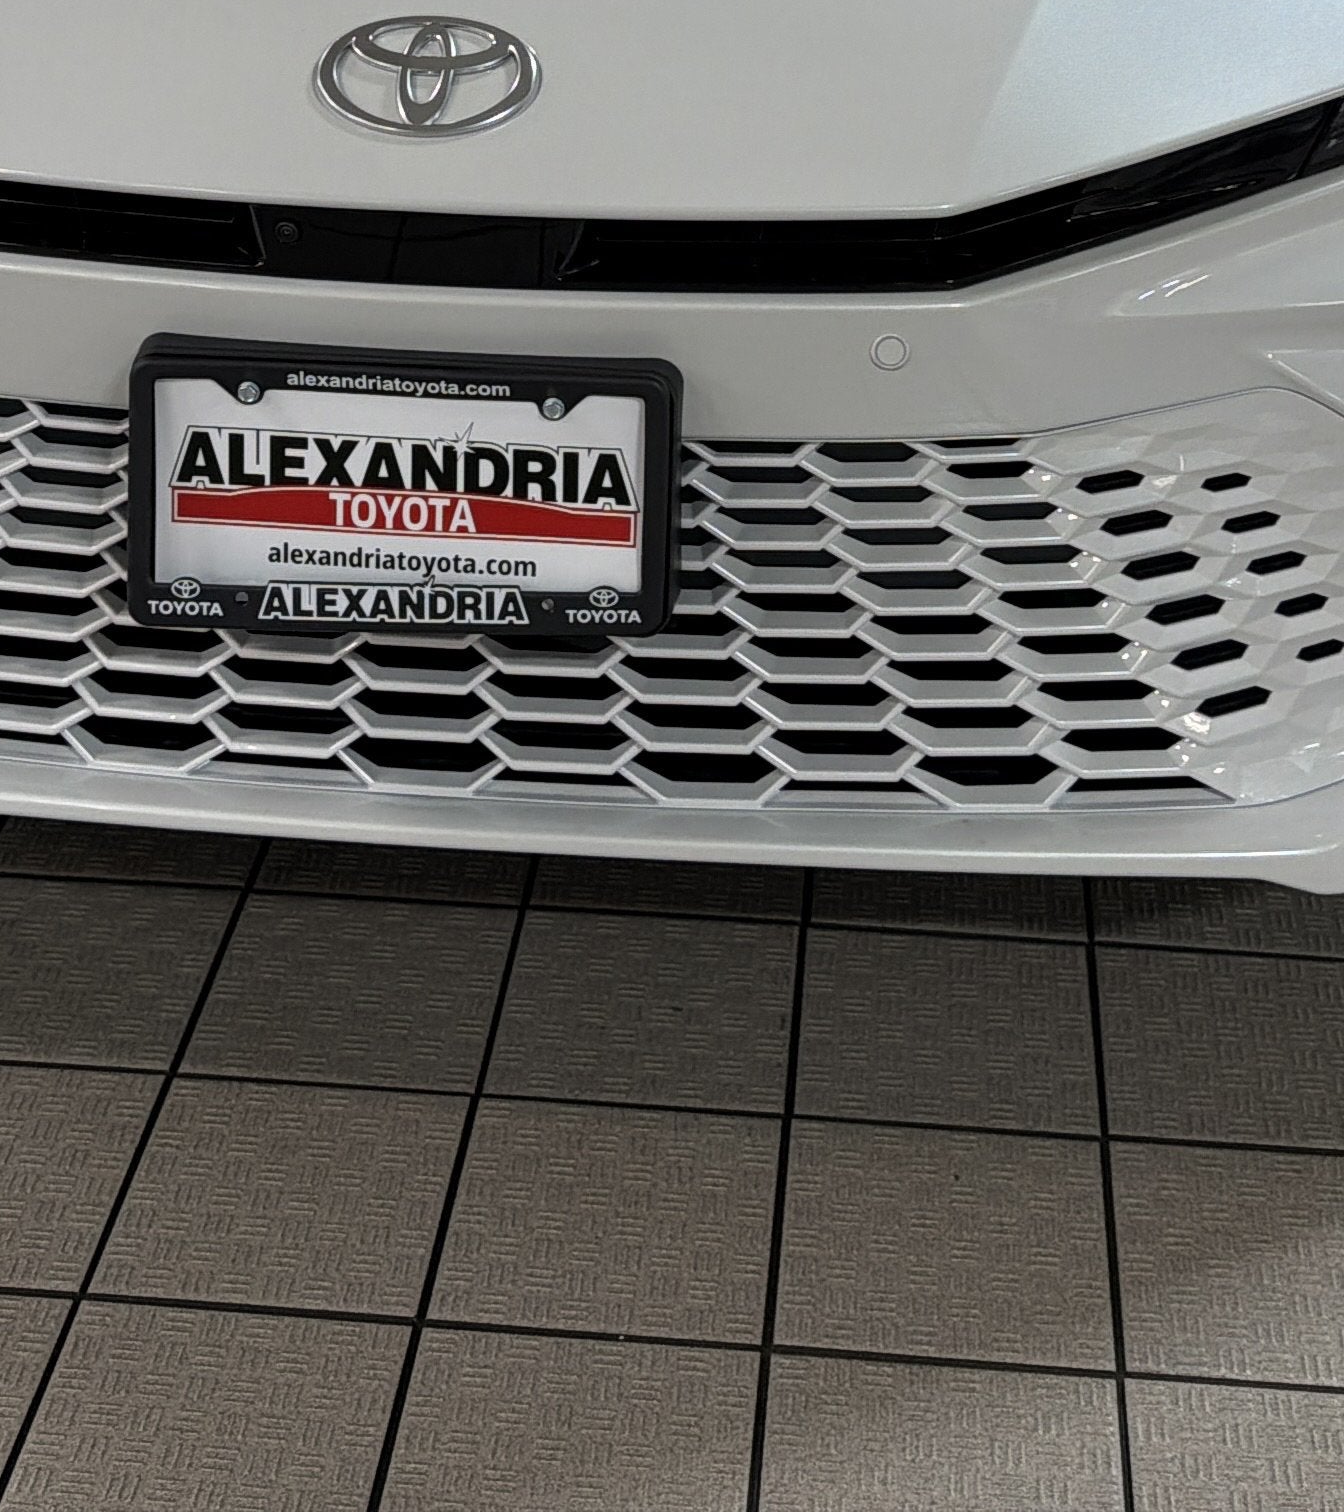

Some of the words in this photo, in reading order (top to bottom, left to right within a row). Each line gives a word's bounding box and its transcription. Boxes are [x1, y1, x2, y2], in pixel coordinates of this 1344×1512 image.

[286, 370, 511, 398] alexandriatoyota.com
[173, 426, 639, 511] ALEXANDRIA
[328, 492, 477, 533] TOYOTA
[267, 542, 537, 578] alexandriatoyota.com
[147, 600, 224, 617] TOYOTA
[258, 583, 530, 625] ALEXANDRIA
[565, 609, 642, 625] TOYOTA
